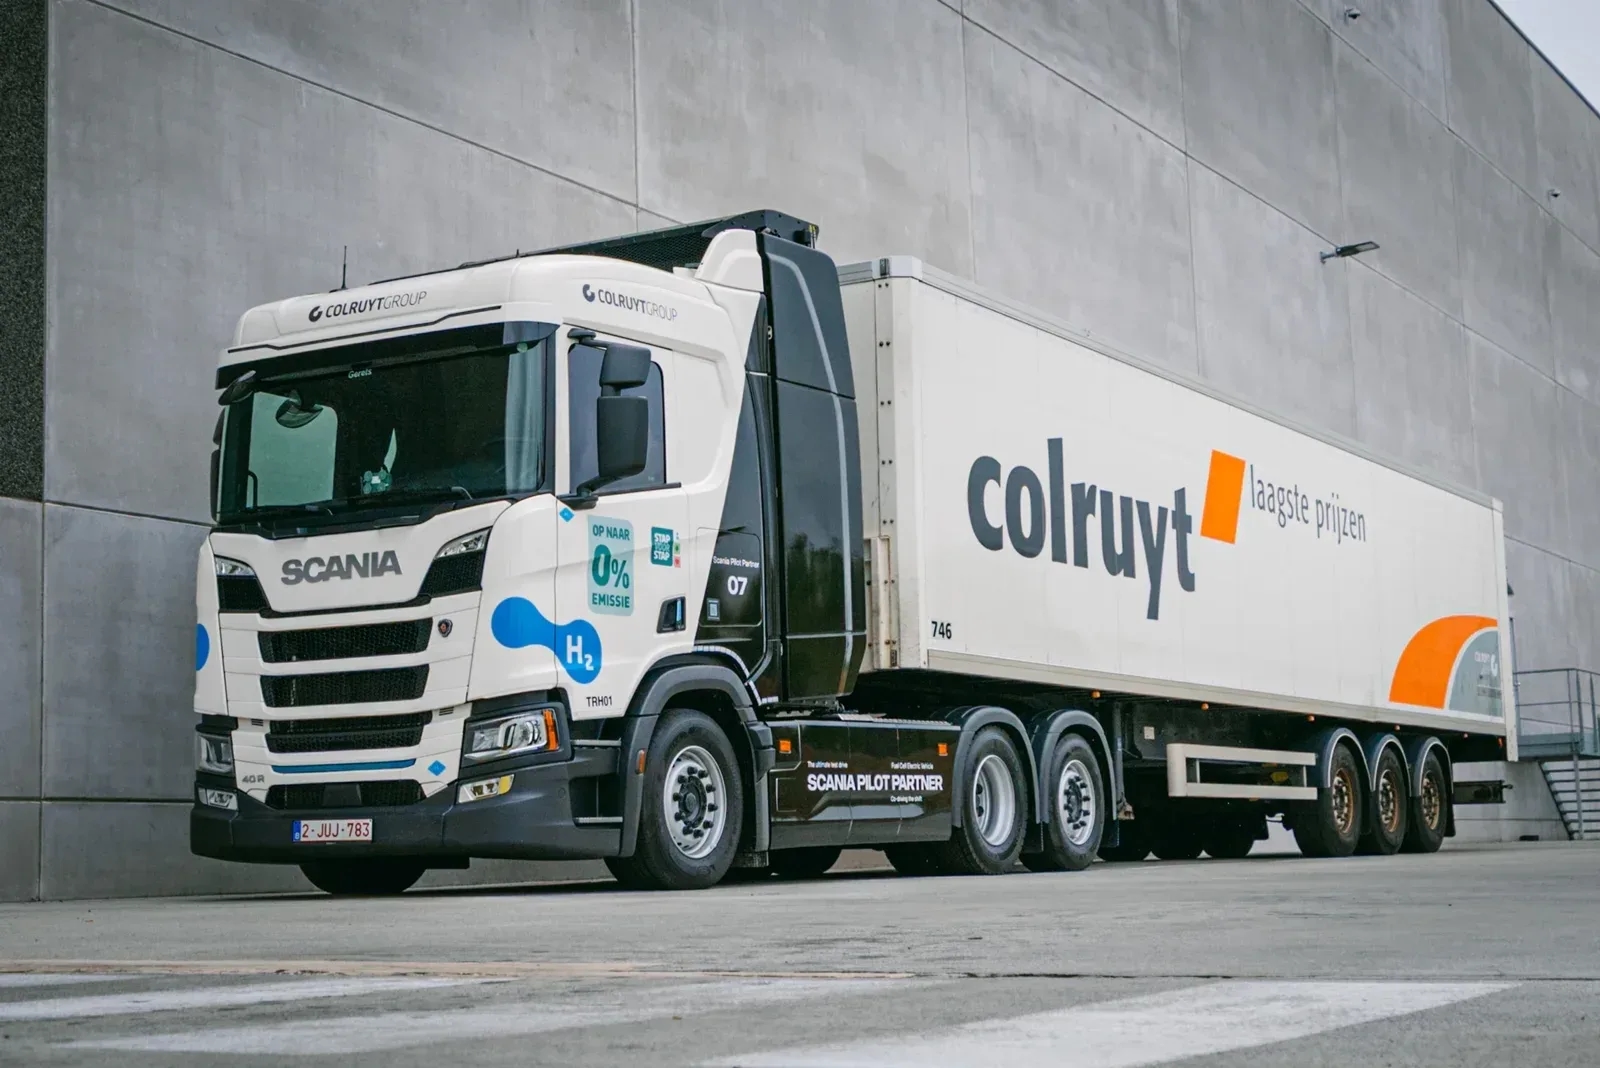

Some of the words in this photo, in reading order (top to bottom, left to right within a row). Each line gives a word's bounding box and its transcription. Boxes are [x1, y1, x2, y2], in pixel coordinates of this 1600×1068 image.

[1250, 464, 1309, 528] laagste
[1315, 492, 1366, 545] prijzen
[592, 524, 605, 537] OP
[606, 526, 630, 541] NAAR
[654, 532, 671, 543] STAP
[967, 437, 1195, 621] colruyt
[653, 550, 670, 561] STAP
[712, 556, 730, 566] Scania
[730, 557, 742, 567] Pilot
[742, 559, 760, 569] Partner
[280, 549, 403, 586] SCANIA
[592, 544, 630, 589] 0%
[727, 575, 748, 596] 07
[592, 593, 630, 608] EMISSIE
[931, 620, 952, 640] 746
[586, 695, 613, 707] TRH01
[241, 774, 256, 784] 40
[257, 774, 265, 783] R
[807, 773, 856, 791] SCANIA
[857, 774, 890, 791] PILOT
[891, 774, 944, 791] PARTNER
